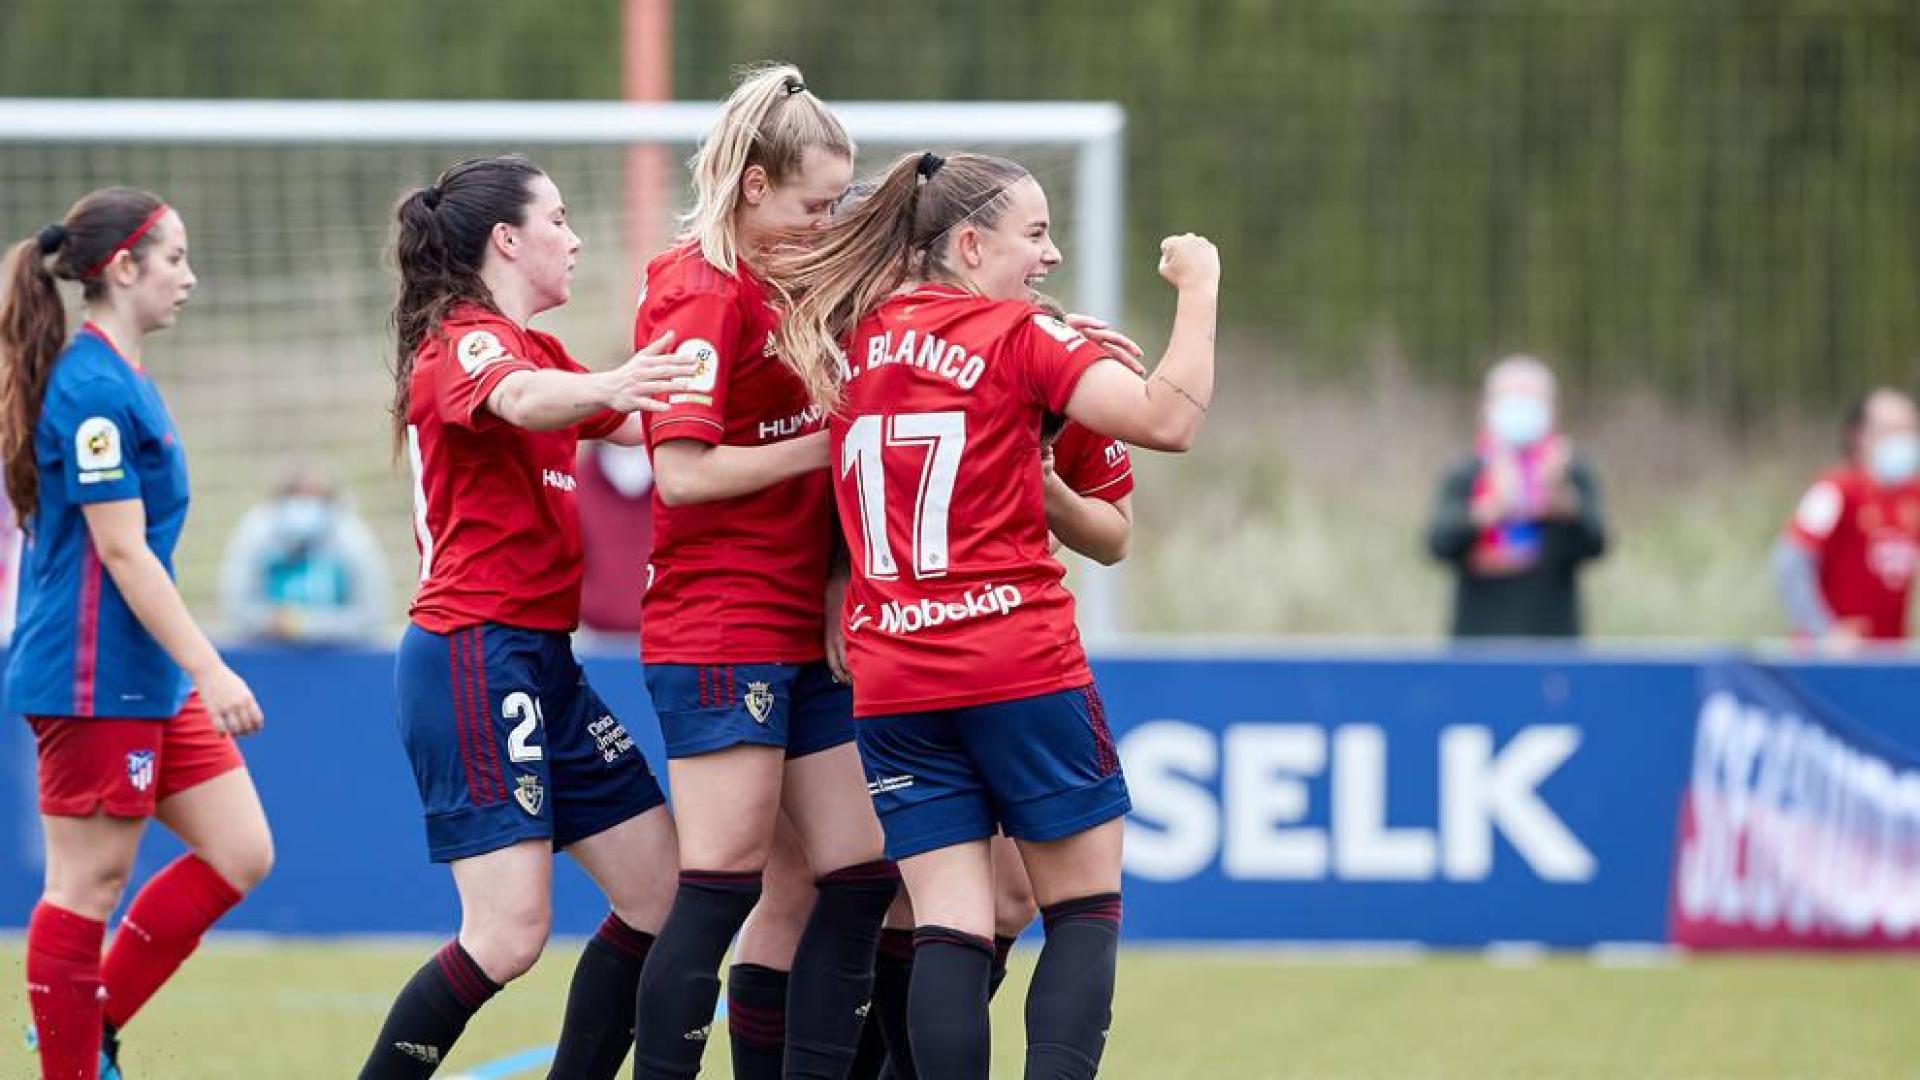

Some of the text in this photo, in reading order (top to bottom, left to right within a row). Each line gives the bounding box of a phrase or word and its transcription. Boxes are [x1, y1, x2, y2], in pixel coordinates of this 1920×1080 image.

[866, 329, 986, 391] BLANCO
[841, 411, 966, 581] 17
[501, 691, 546, 762] 2
[1115, 719, 1599, 883] SELK
